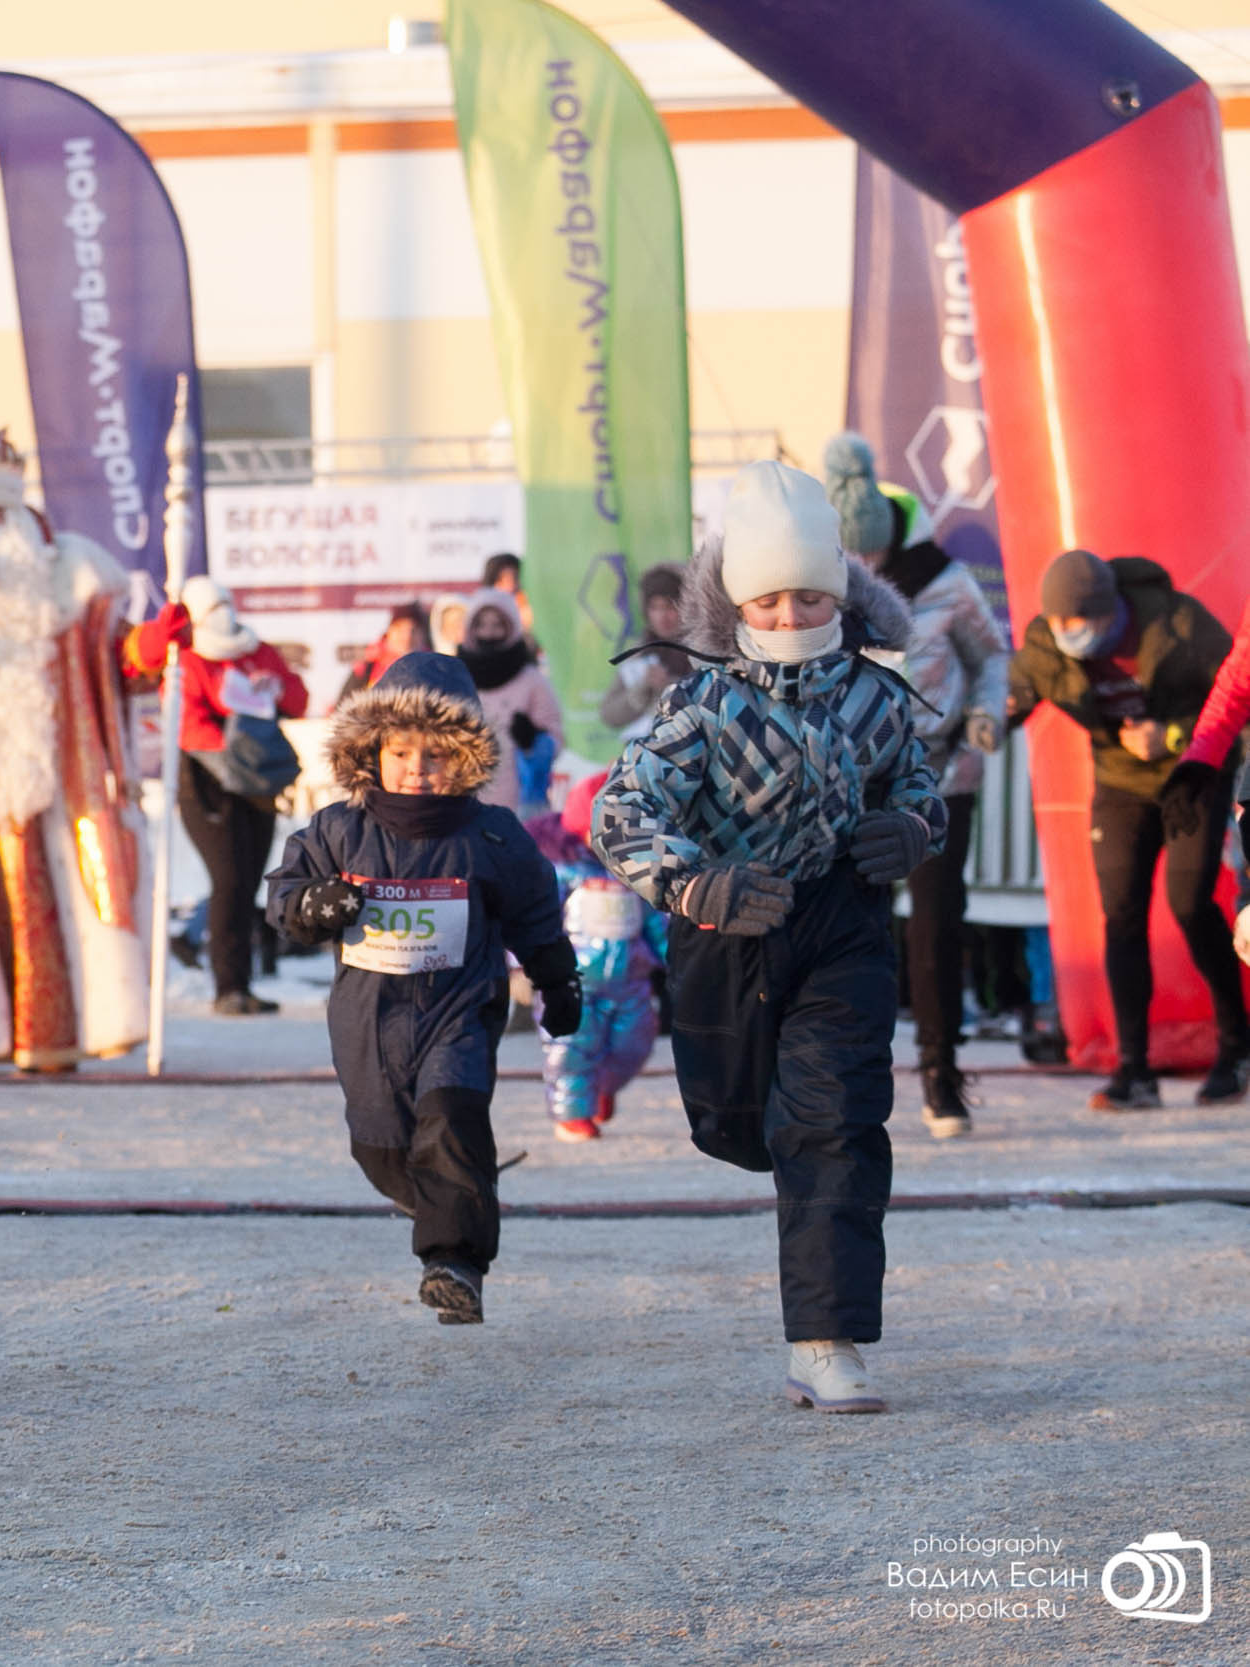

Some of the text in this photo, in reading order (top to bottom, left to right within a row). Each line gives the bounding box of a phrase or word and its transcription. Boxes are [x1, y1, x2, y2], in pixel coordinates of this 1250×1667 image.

[226, 503, 379, 533] БЕГУЩАЯ
[226, 541, 378, 569] ВОЛОГДА
[374, 885, 406, 899] 300
[365, 906, 436, 940] 305
